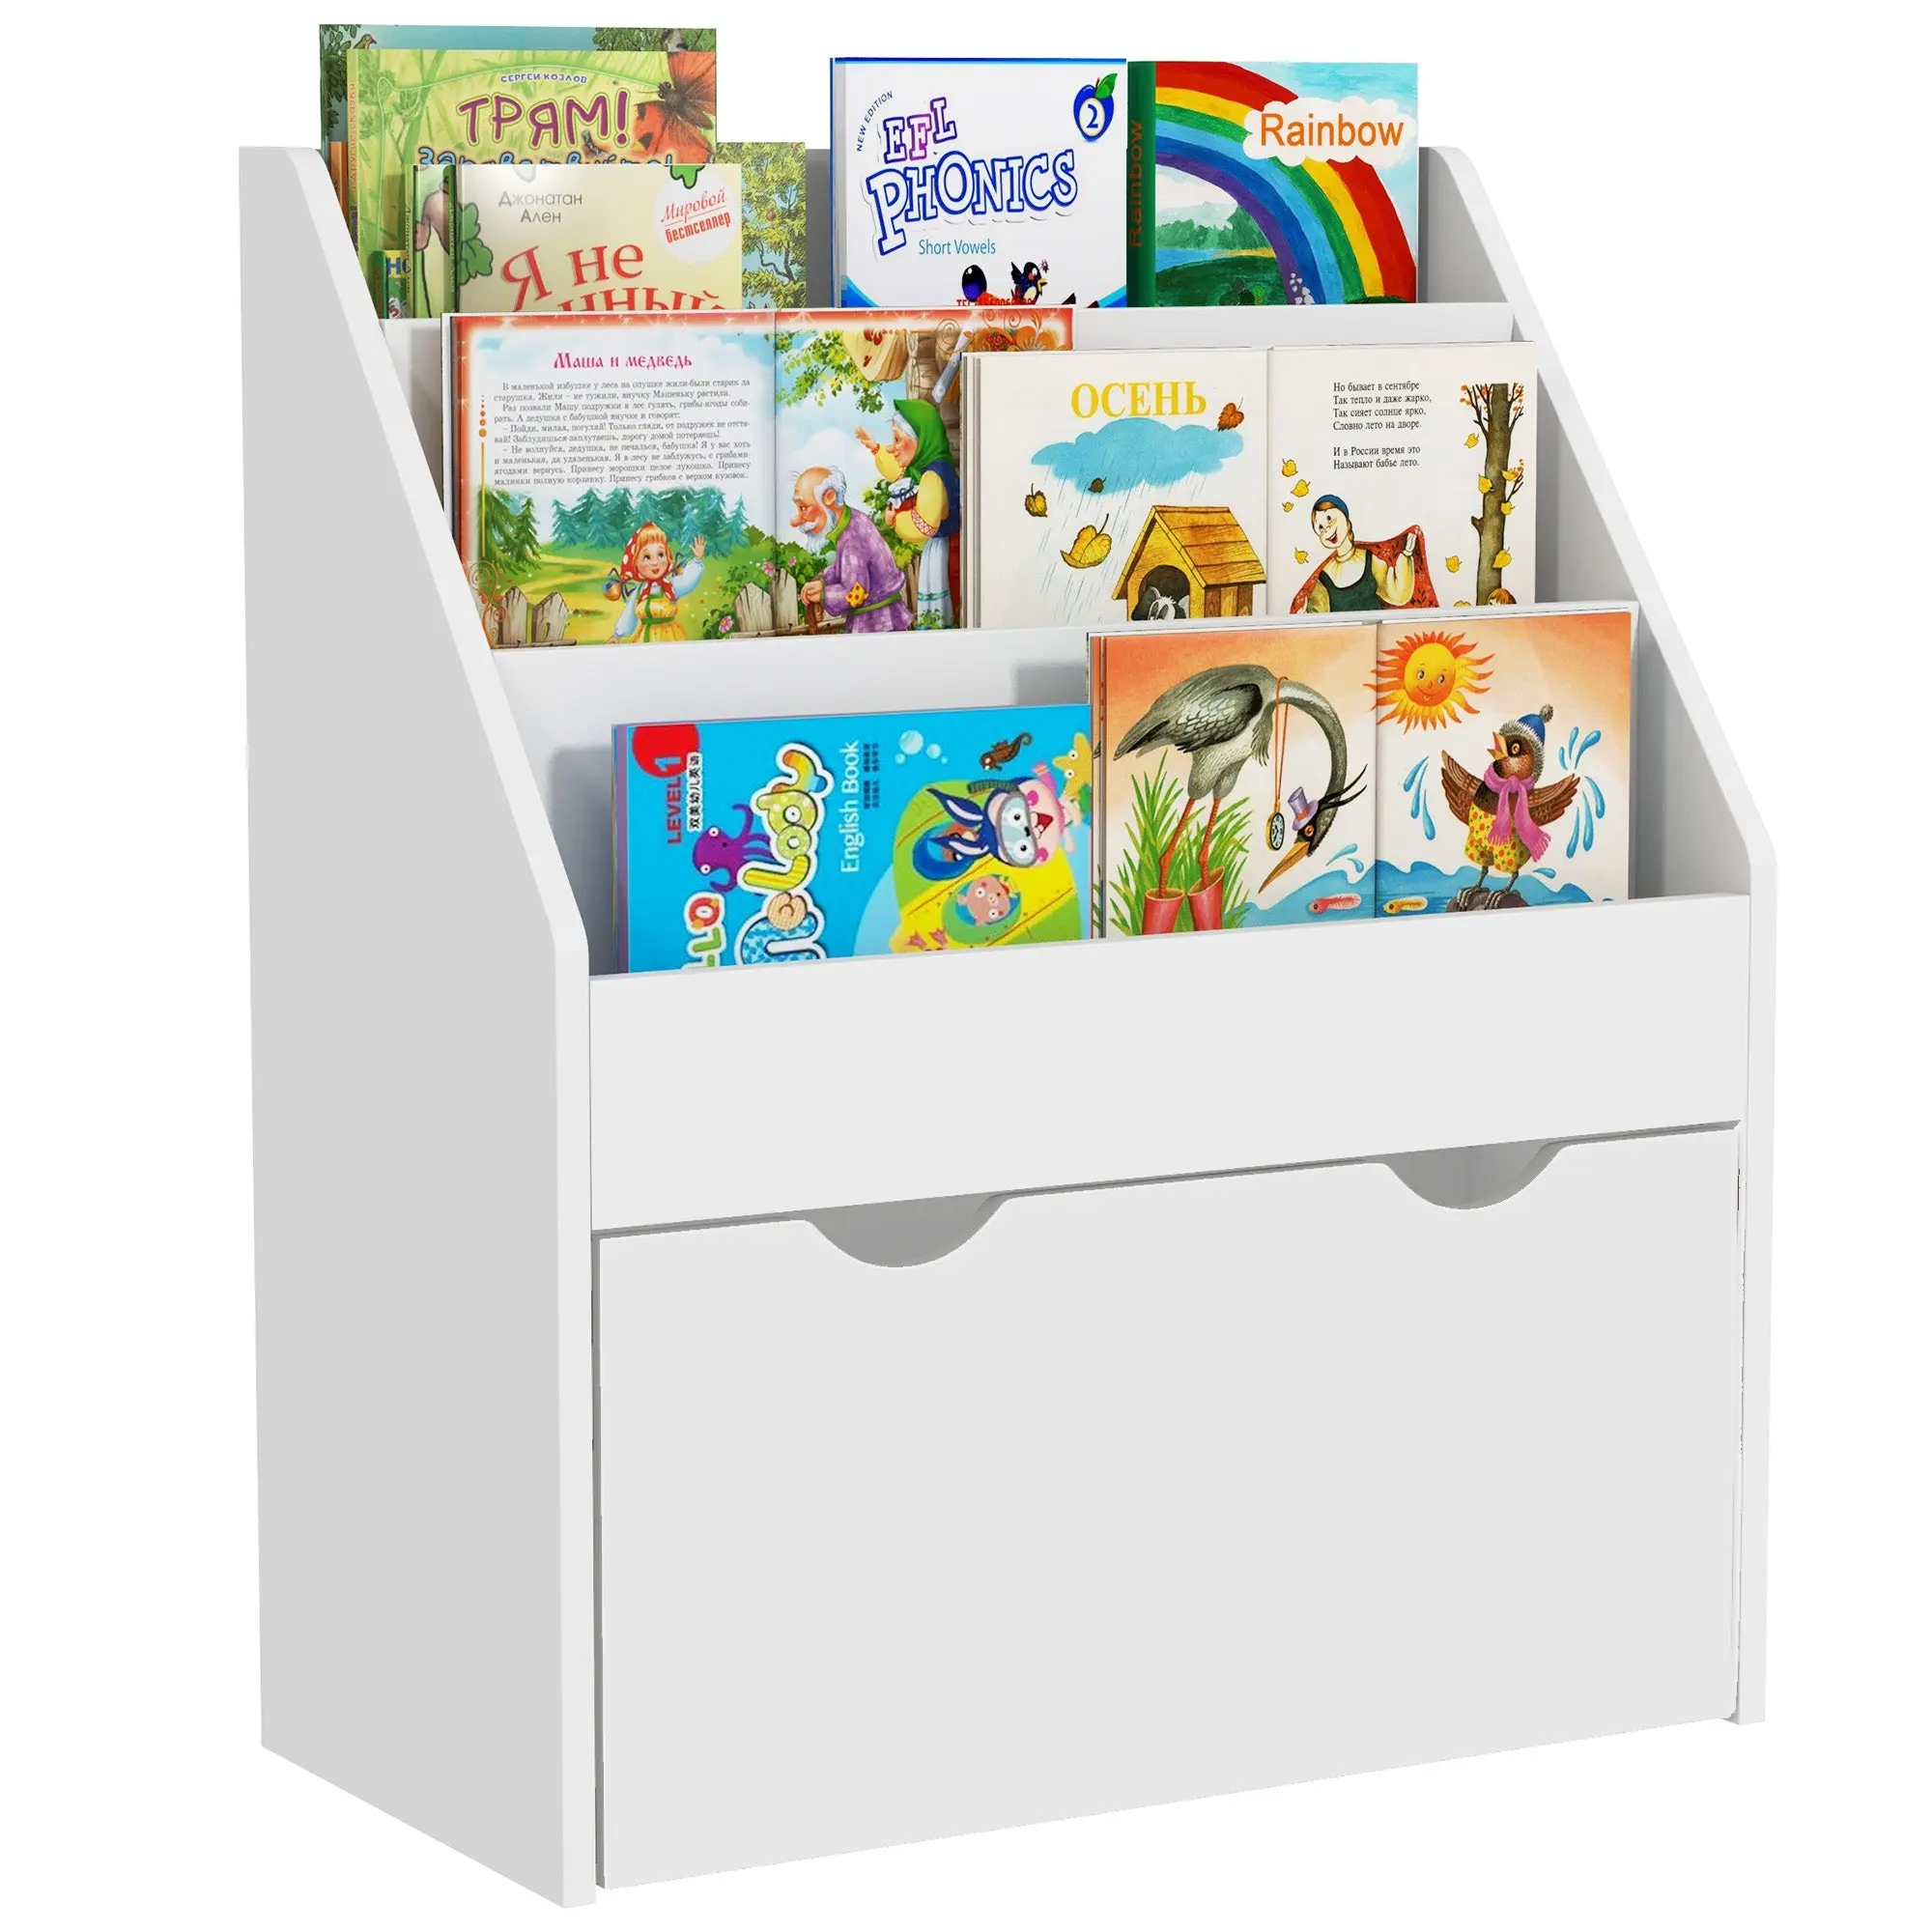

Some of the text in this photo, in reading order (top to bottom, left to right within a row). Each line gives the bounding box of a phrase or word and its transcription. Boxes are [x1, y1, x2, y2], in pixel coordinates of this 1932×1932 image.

[543, 73, 587, 84] КОЗЛОВ
[457, 89, 630, 149] ТРЯМ!
[856, 90, 894, 152] NEW EDITION
[1086, 103, 1099, 129] 2
[1261, 113, 1405, 147] Rainbow
[882, 97, 957, 164] EFL
[1129, 120, 1142, 247] Rainbow
[497, 190, 582, 207] Джонатан
[661, 188, 725, 223] Мировой
[866, 149, 1078, 256] PHONICS
[520, 209, 561, 223] Ален
[665, 212, 731, 243] бестселлер
[919, 239, 996, 255] Short Vowels
[501, 243, 643, 312] Я не
[554, 353, 693, 370] Маша и медведь
[1070, 381, 1207, 418] ОСЕНЬ
[1333, 383, 1345, 391] Но
[1348, 383, 1375, 391] бывает
[1385, 381, 1419, 391] сентябре
[1333, 396, 1348, 405] Так
[1405, 395, 1432, 404] жарко,
[1333, 409, 1348, 417] Так
[1406, 408, 1426, 416] ярко,
[1333, 421, 1363, 430] Словно
[1398, 421, 1421, 430] дворе.
[1333, 460, 1373, 469] Называют
[1376, 459, 1397, 468] бабье
[1351, 446, 1378, 455] России
[1382, 447, 1405, 456] время
[654, 756, 681, 844] LEVEL 1
[839, 741, 865, 872] English Book
